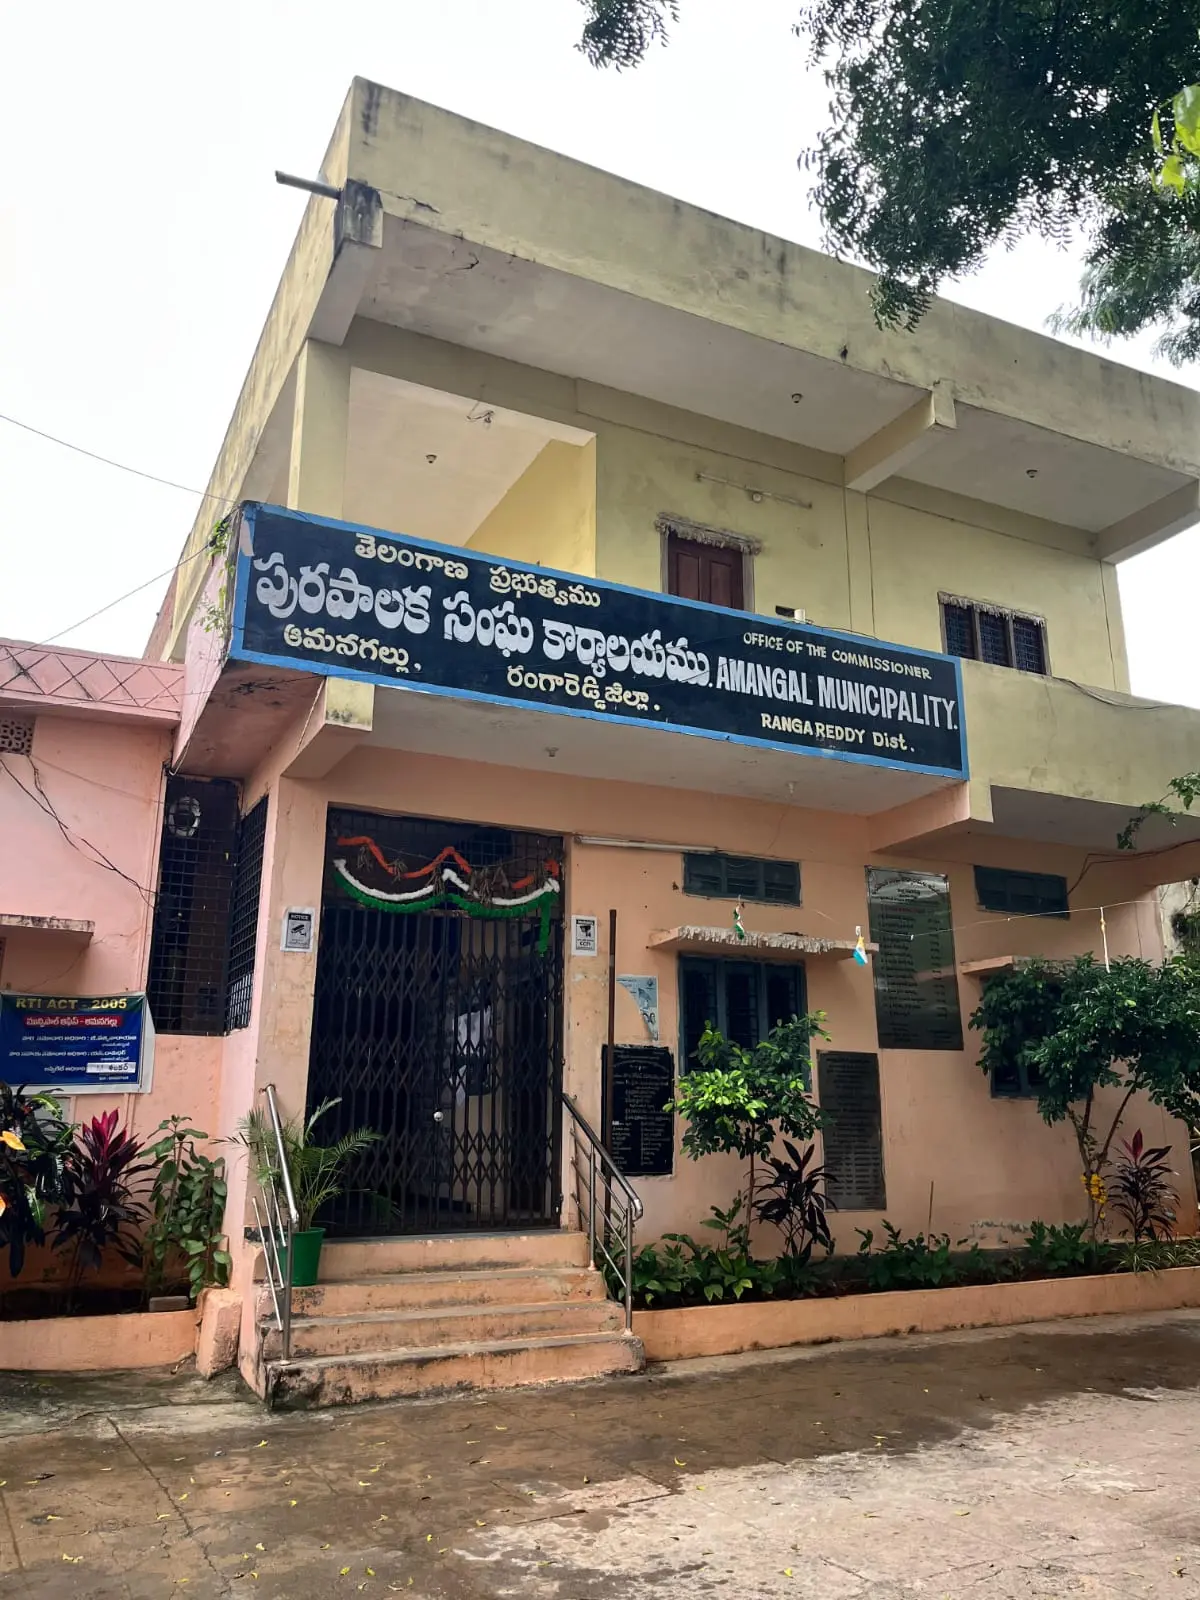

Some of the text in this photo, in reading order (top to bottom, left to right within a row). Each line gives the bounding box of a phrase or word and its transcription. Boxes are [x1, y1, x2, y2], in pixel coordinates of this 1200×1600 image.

[355, 532, 601, 608] తెలంగాణ ప్రభుత్వము
[253, 551, 432, 635] పురపాలక
[443, 590, 534, 658] సంఘ
[743, 631, 932, 681] OFFICE OF THE COMMISSIONER
[716, 656, 959, 731] AMANGAL MUNICIPALITY.
[761, 713, 915, 752] RANGA REDDY Dist.
[16, 998, 42, 1009] RTI
[47, 999, 78, 1010] ACT
[92, 998, 128, 1010] 2005
